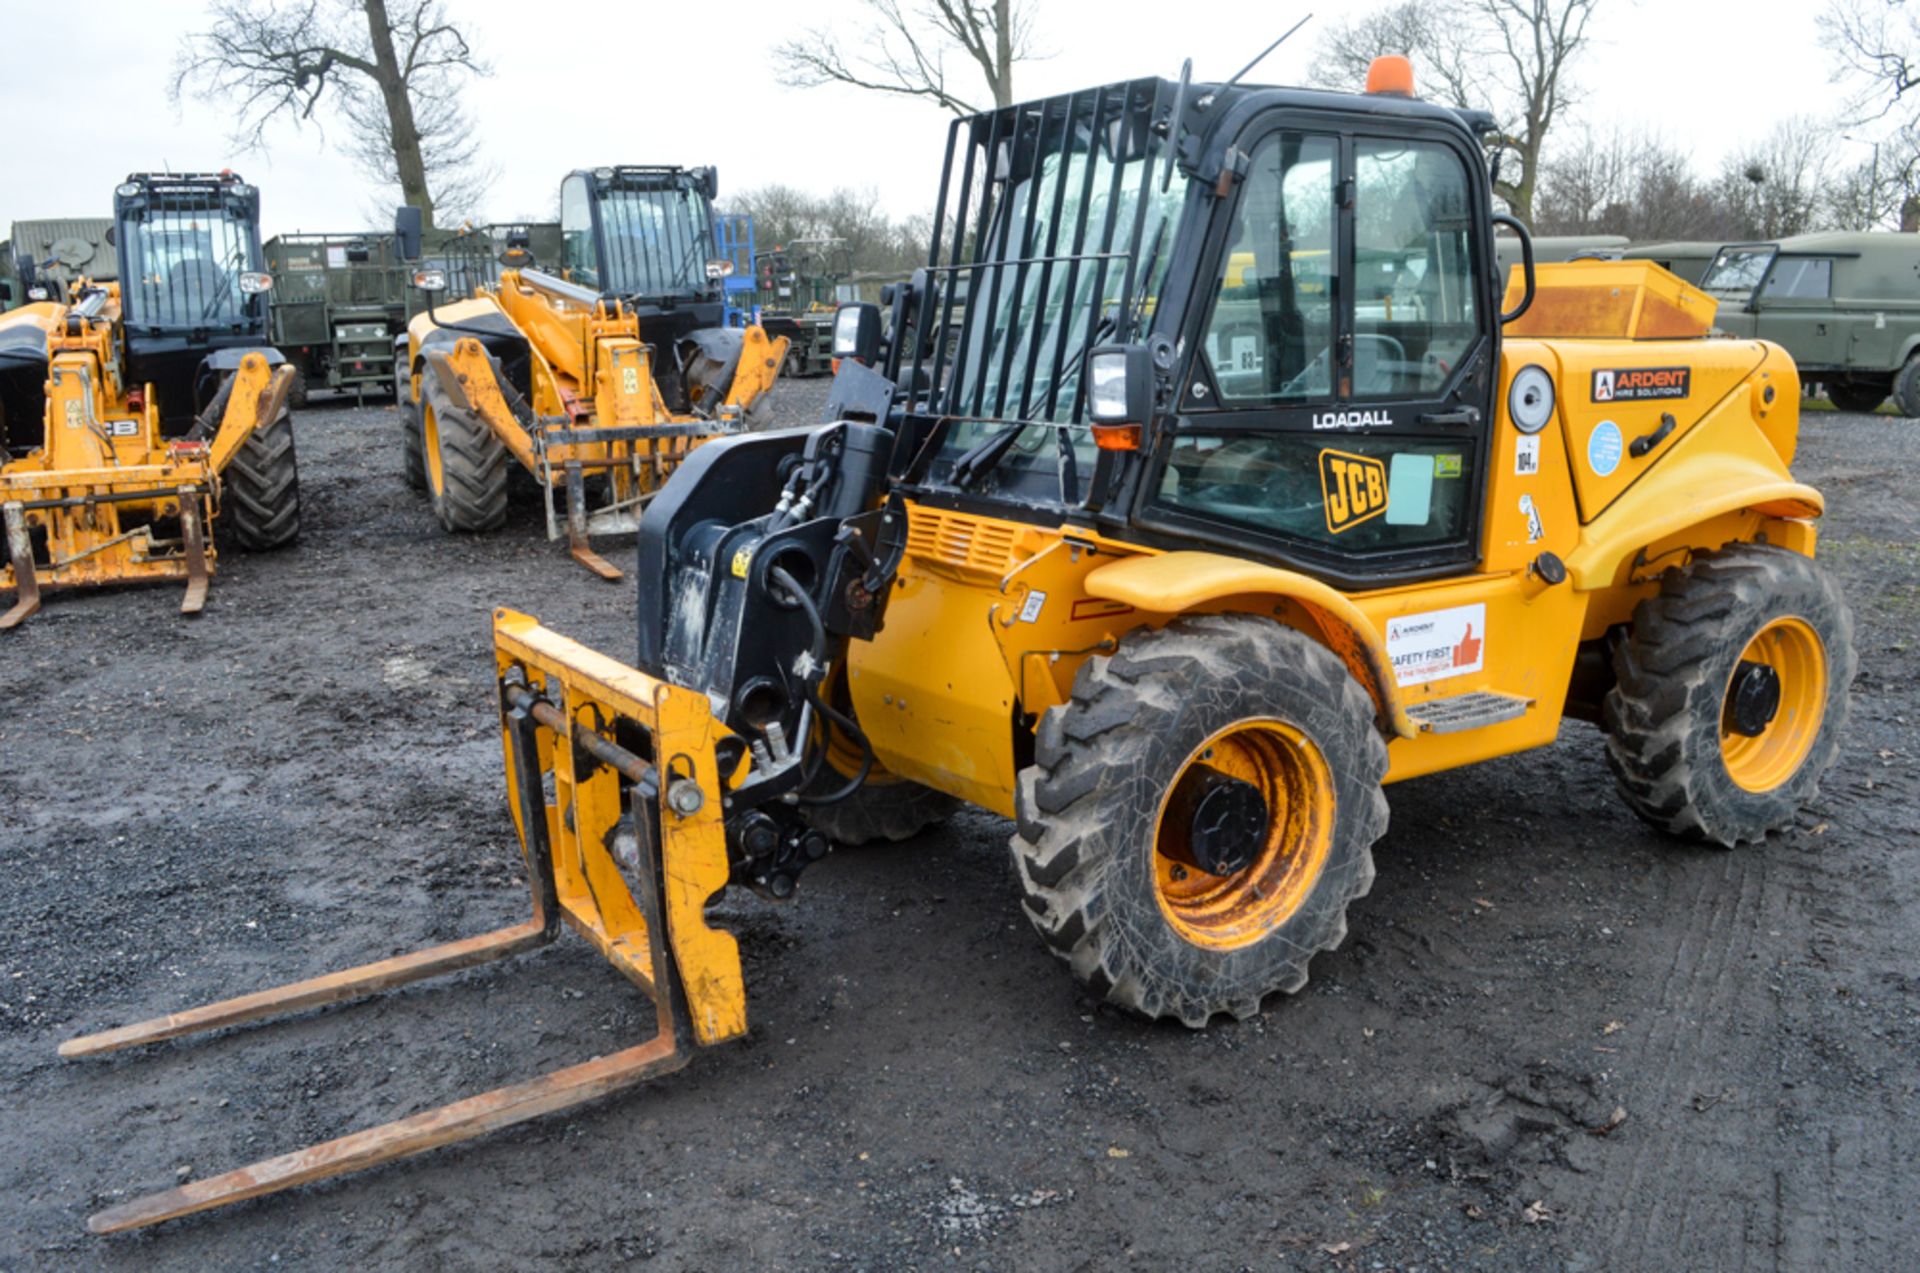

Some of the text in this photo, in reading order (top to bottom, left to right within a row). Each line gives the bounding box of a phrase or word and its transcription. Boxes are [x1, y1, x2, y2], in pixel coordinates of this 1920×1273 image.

[1616, 370, 1687, 388] ARDENT
[1615, 386, 1683, 397] HIRE SOLUTIONS
[1312, 410, 1393, 430] LOADALL
[1329, 458, 1384, 524] JCB
[1426, 646, 1451, 660] FIRST
